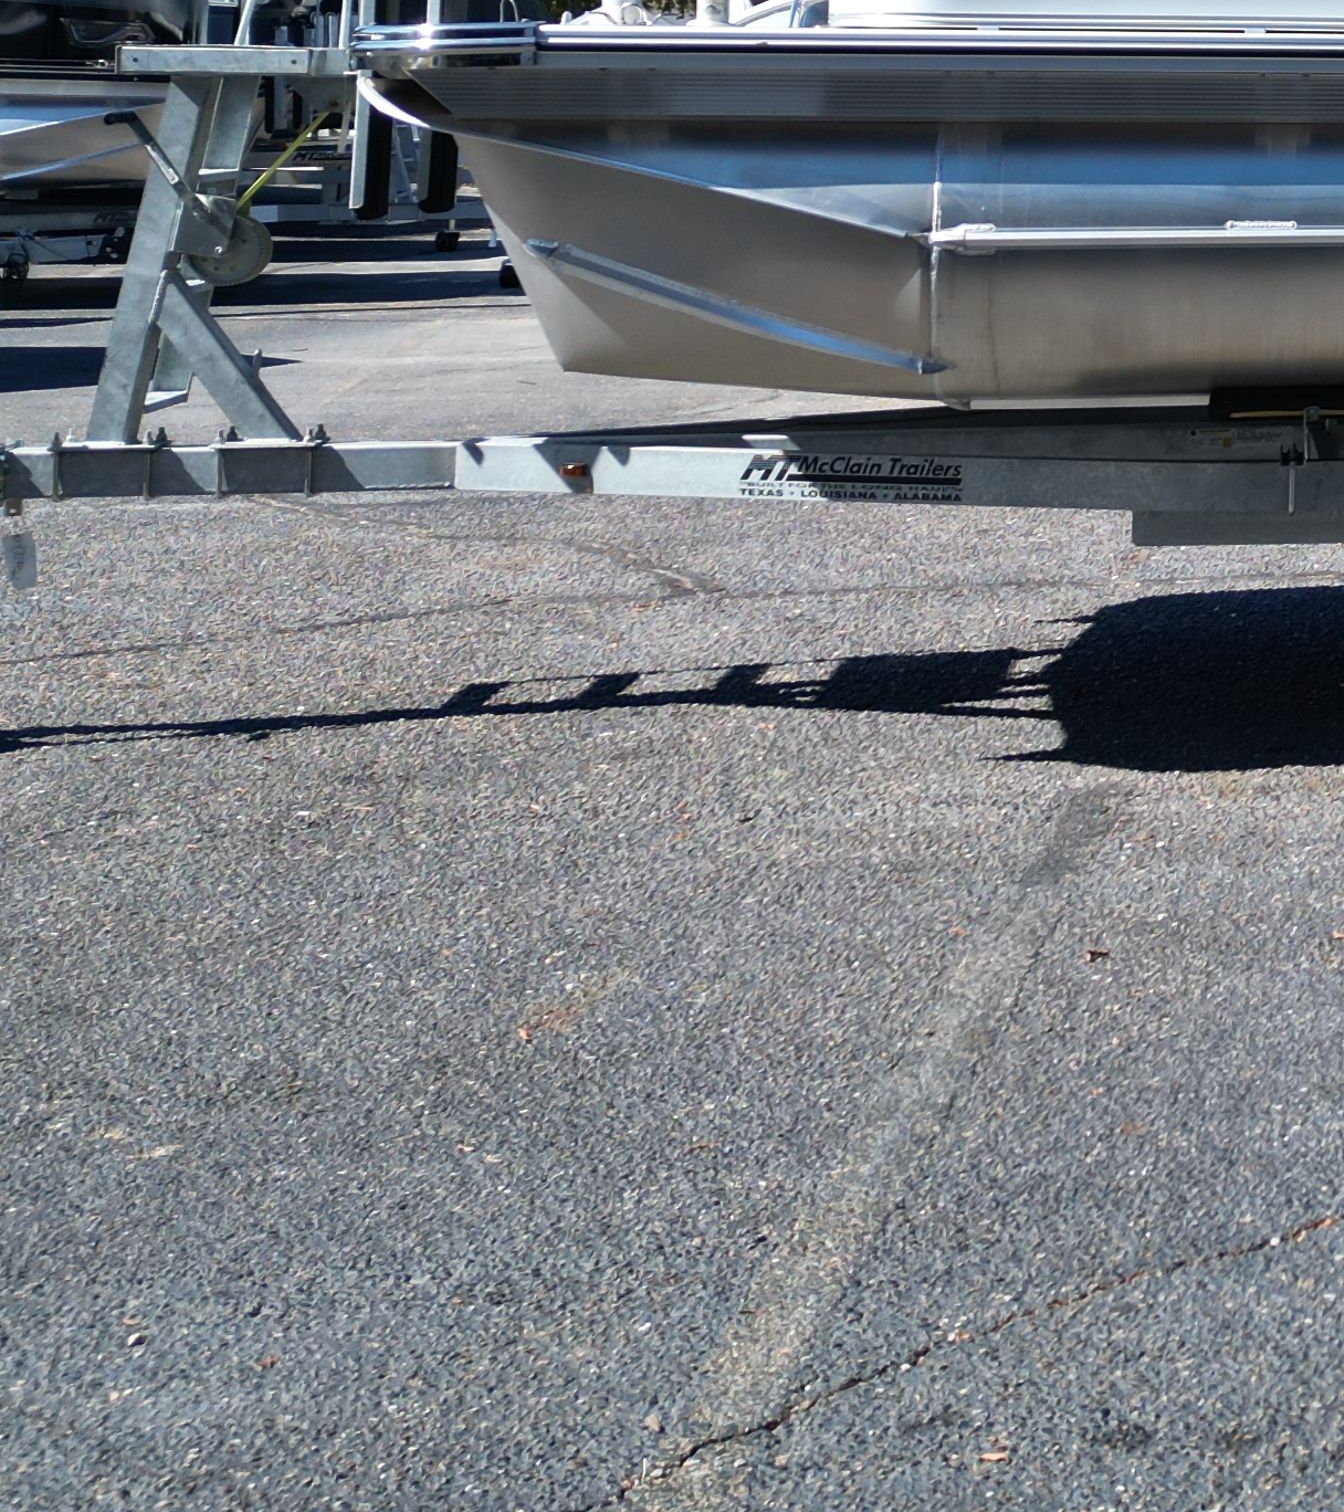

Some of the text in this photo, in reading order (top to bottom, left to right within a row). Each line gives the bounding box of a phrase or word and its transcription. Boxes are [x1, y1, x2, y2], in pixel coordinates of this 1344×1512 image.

[798, 455, 882, 475] McClain
[888, 457, 963, 477] Trailers
[740, 488, 963, 502] TEXAS LOUISIANA ALABAMA
